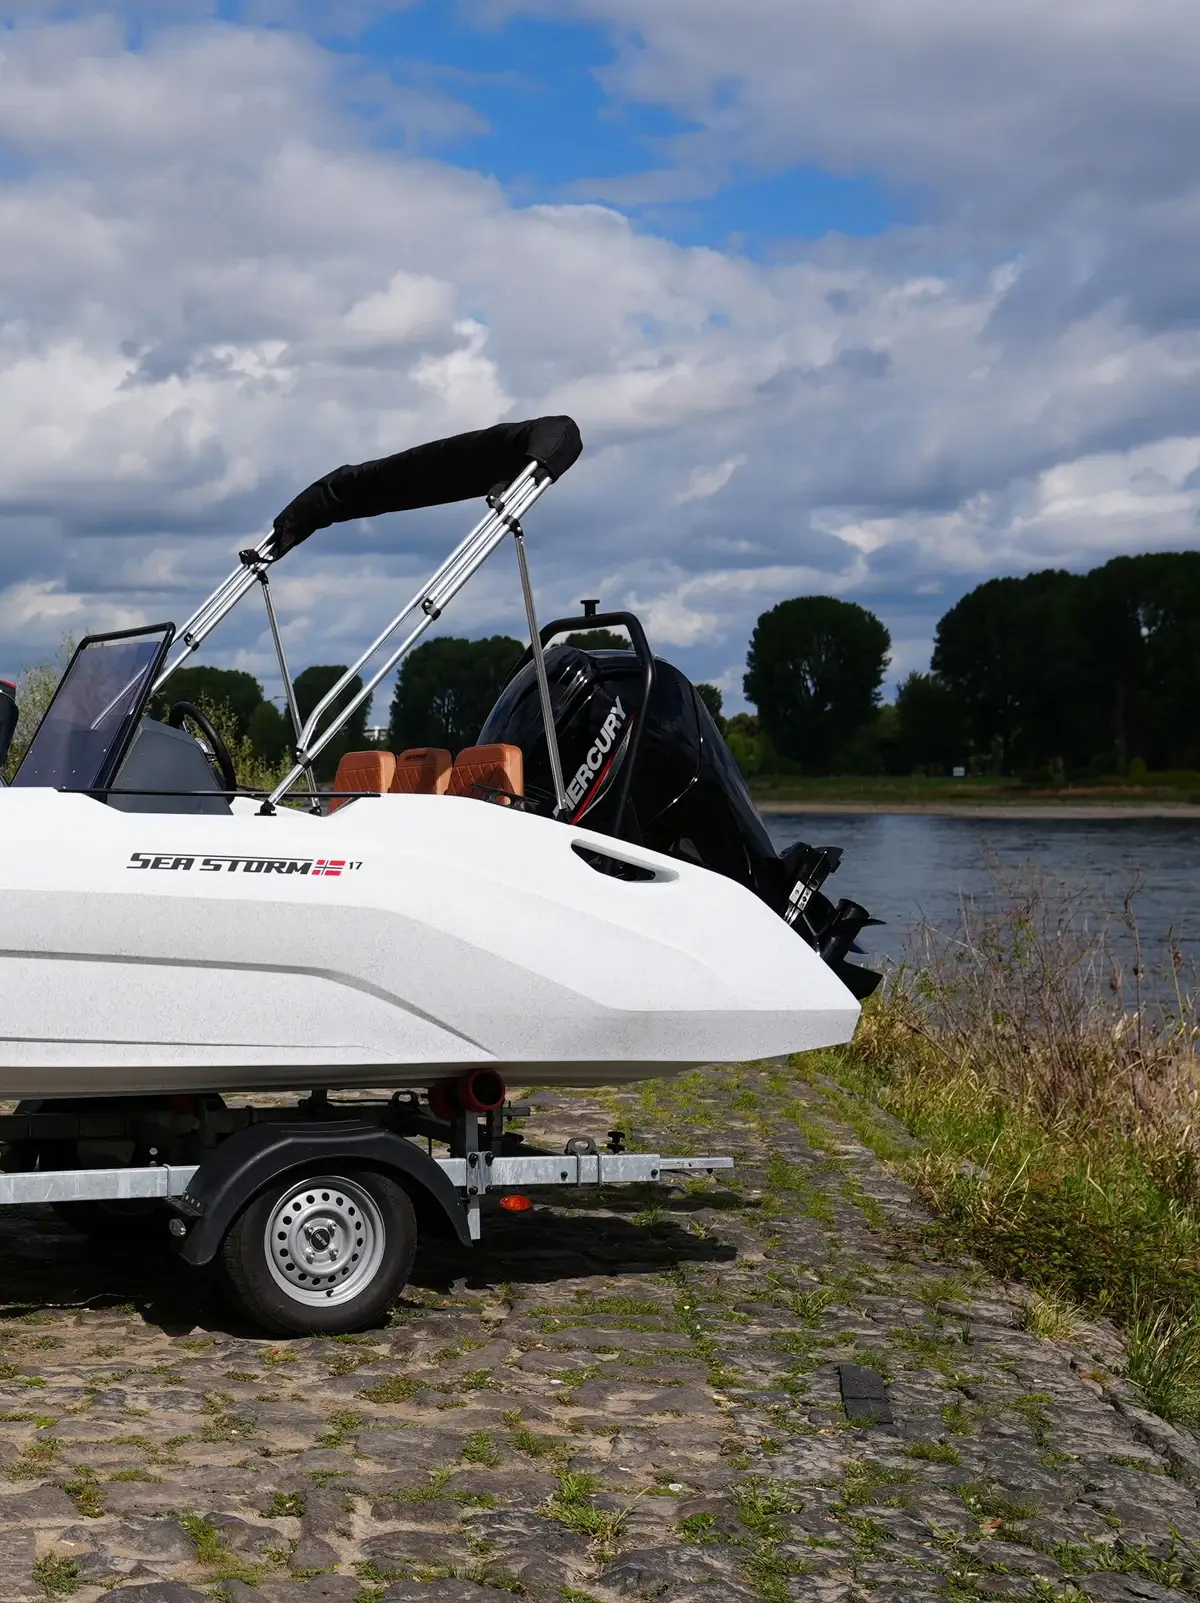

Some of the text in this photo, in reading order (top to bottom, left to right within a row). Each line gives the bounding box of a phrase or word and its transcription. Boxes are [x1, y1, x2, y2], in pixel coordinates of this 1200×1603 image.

[126, 852, 363, 876] SEA STORM 17
